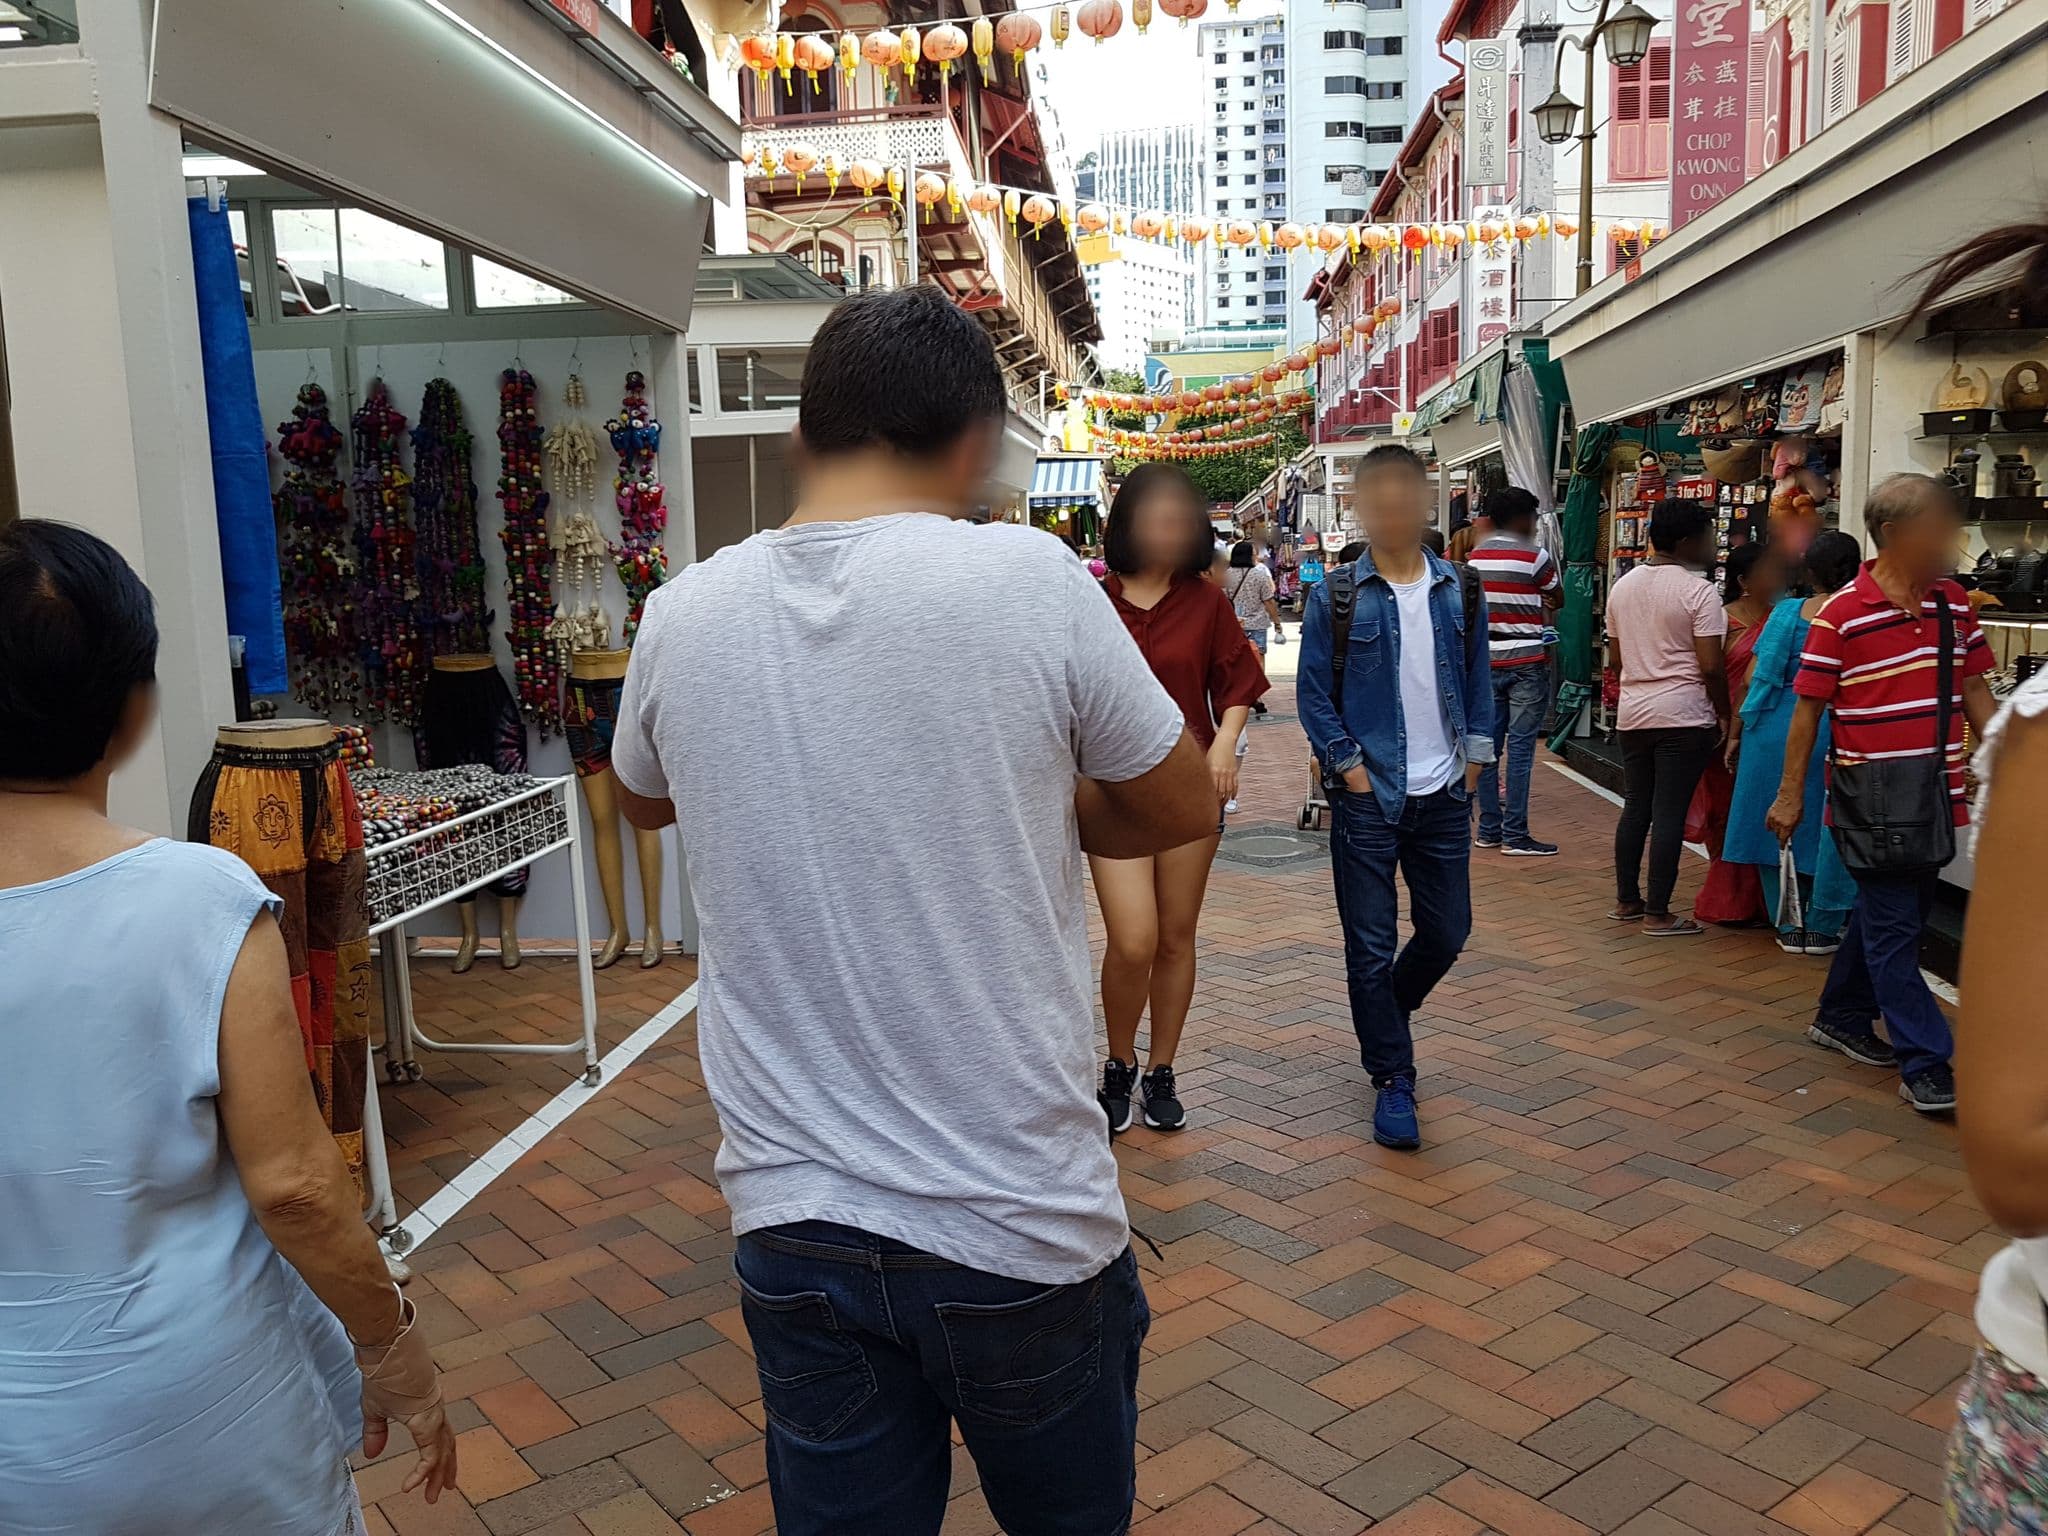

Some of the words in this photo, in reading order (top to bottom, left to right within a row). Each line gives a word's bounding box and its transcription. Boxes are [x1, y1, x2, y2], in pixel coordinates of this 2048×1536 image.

[1687, 133, 1732, 151] CHOP
[1677, 157, 1741, 176] KWONG
[1690, 184, 1727, 200] ONN
[1684, 485, 1696, 499] for
[1696, 483, 1713, 498] $10
